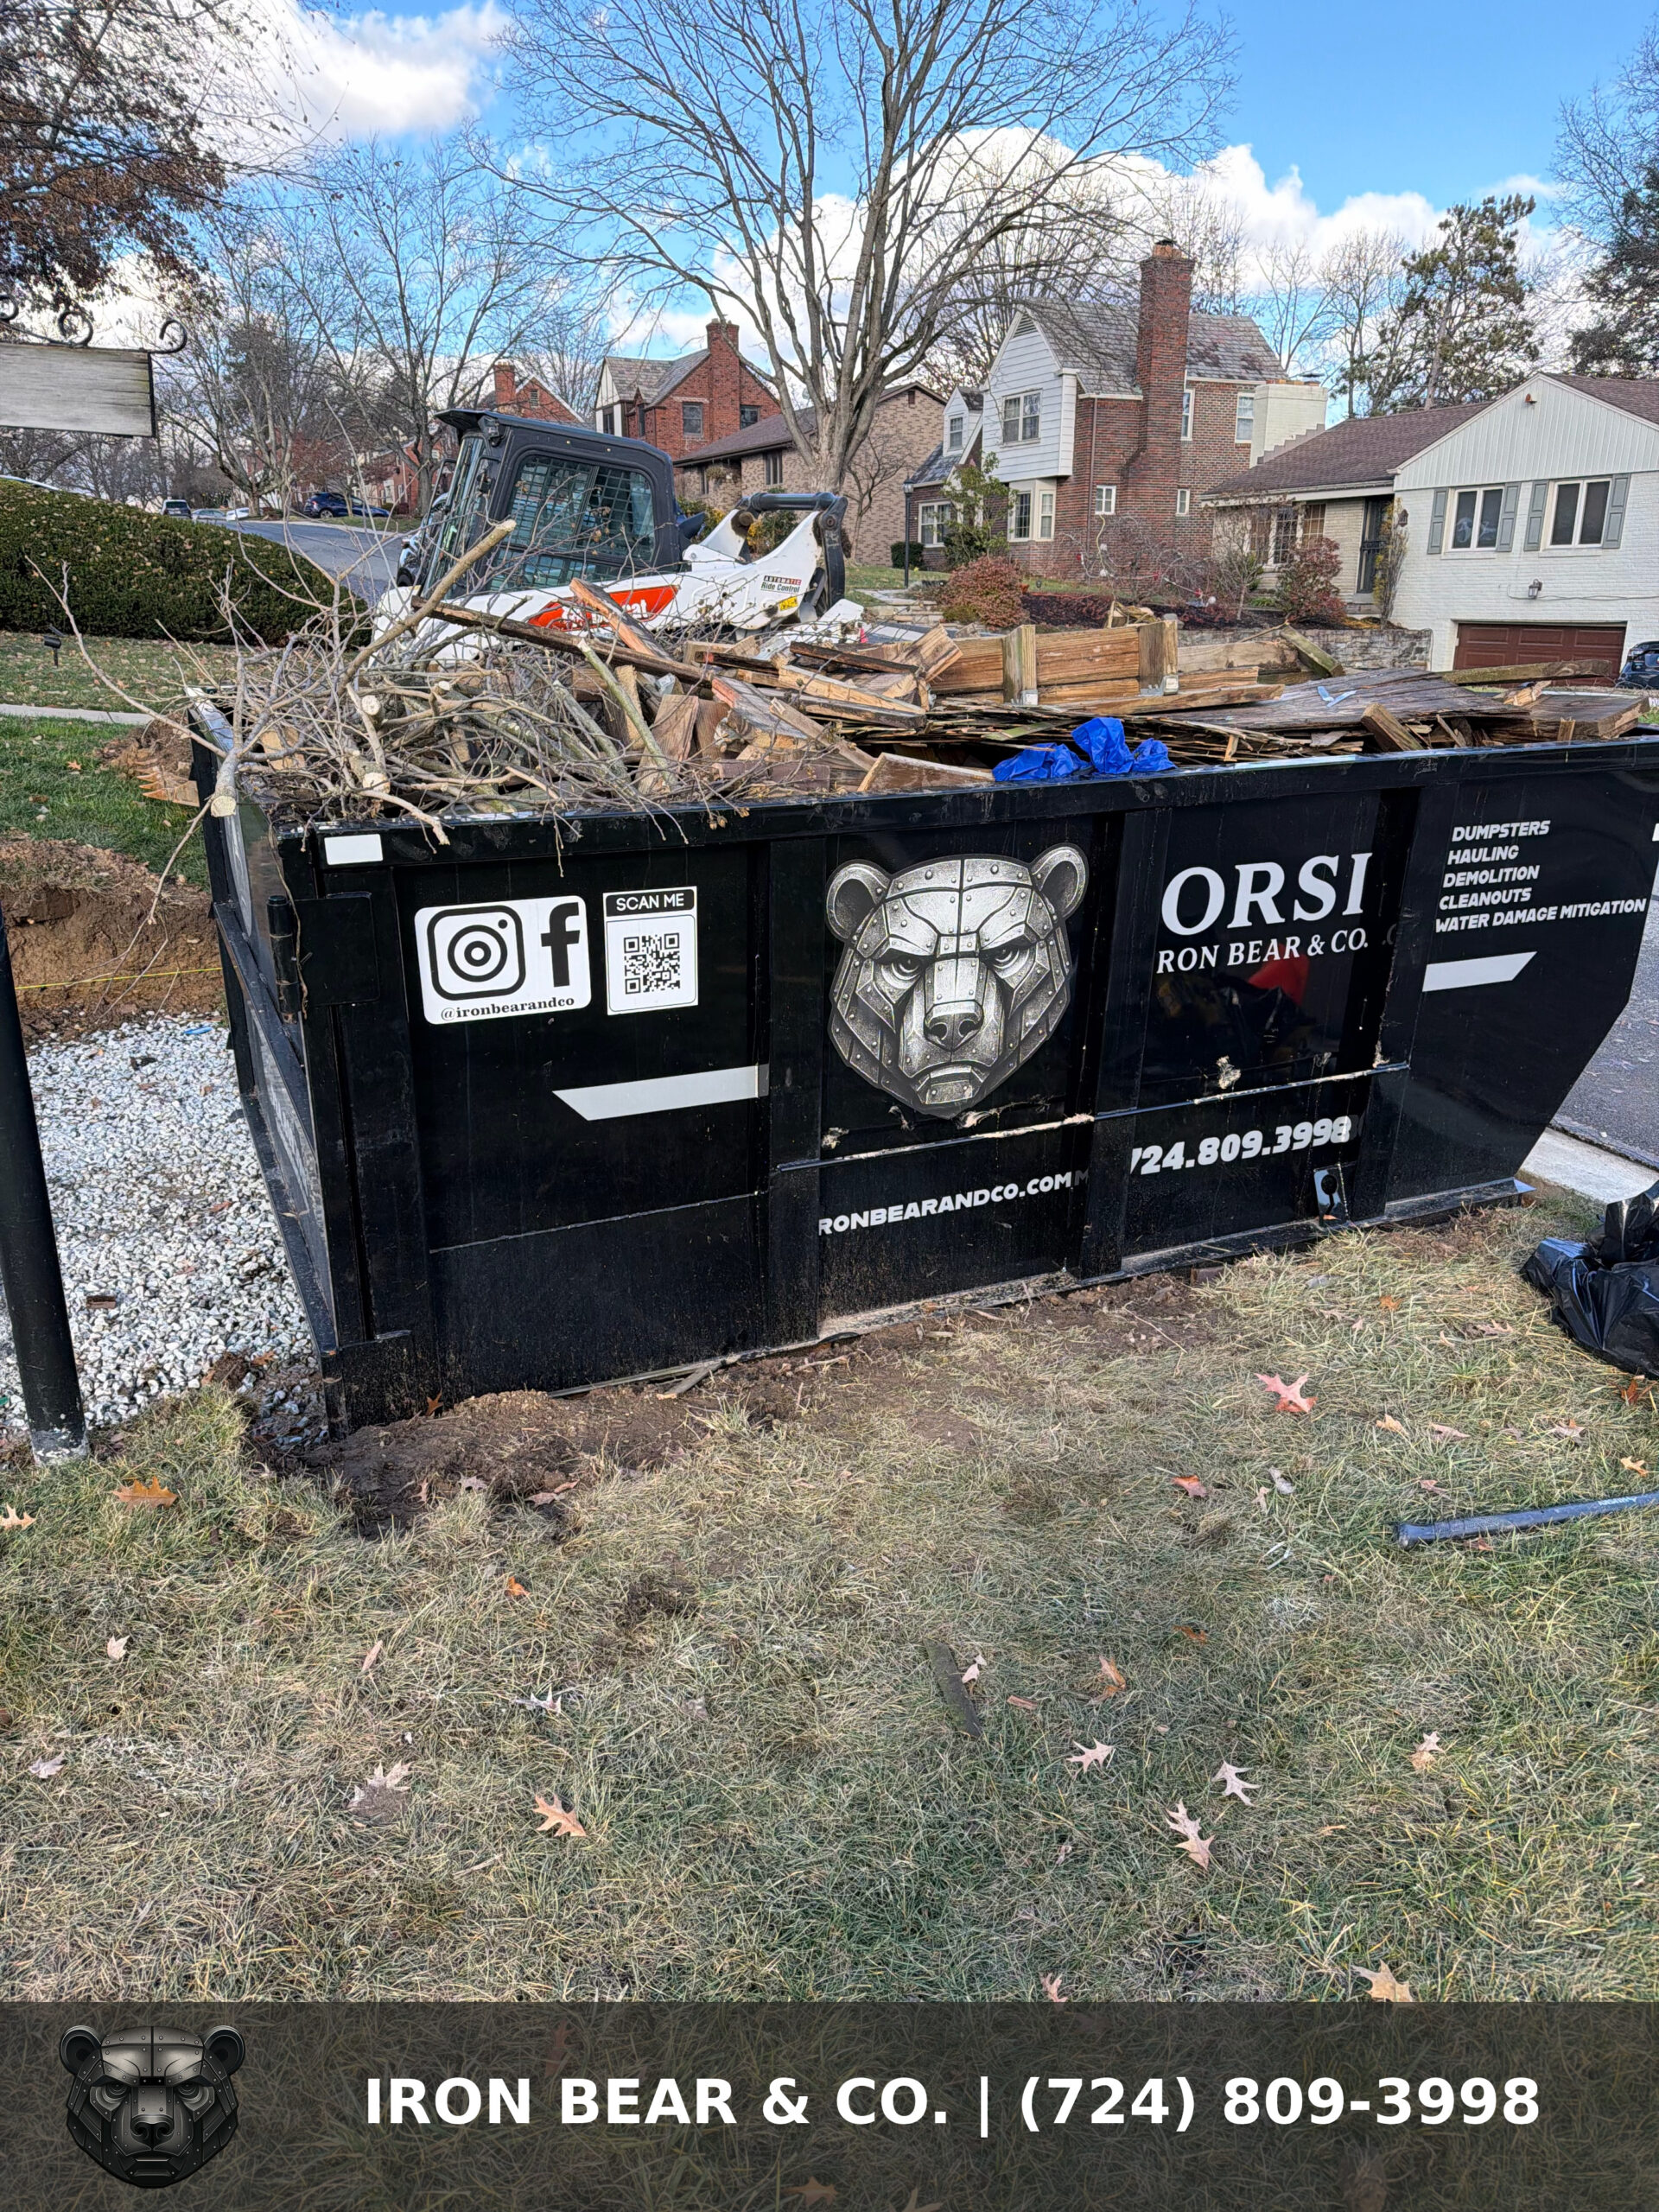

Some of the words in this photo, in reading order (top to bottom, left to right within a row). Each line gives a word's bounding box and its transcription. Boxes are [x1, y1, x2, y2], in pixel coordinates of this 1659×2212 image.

[761, 582, 776, 590] Ride
[777, 583, 800, 593] Control
[1452, 820, 1551, 842] DUMPSTERS
[1447, 845, 1520, 865] HAULING
[1442, 865, 1541, 888] DEMOLITION
[616, 895, 659, 912] SCAN
[664, 893, 684, 908] ME
[1161, 852, 1373, 936] ORSI
[1439, 887, 1532, 911] CLEANOUTS
[1435, 912, 1491, 933] WATER
[1491, 906, 1559, 927] DAMAGE
[1559, 898, 1648, 919] MITIGATION
[1226, 936, 1301, 966] BEAR
[1306, 933, 1325, 957] &
[1331, 927, 1370, 953] CO.
[441, 996, 575, 1021] @ironbearandco
